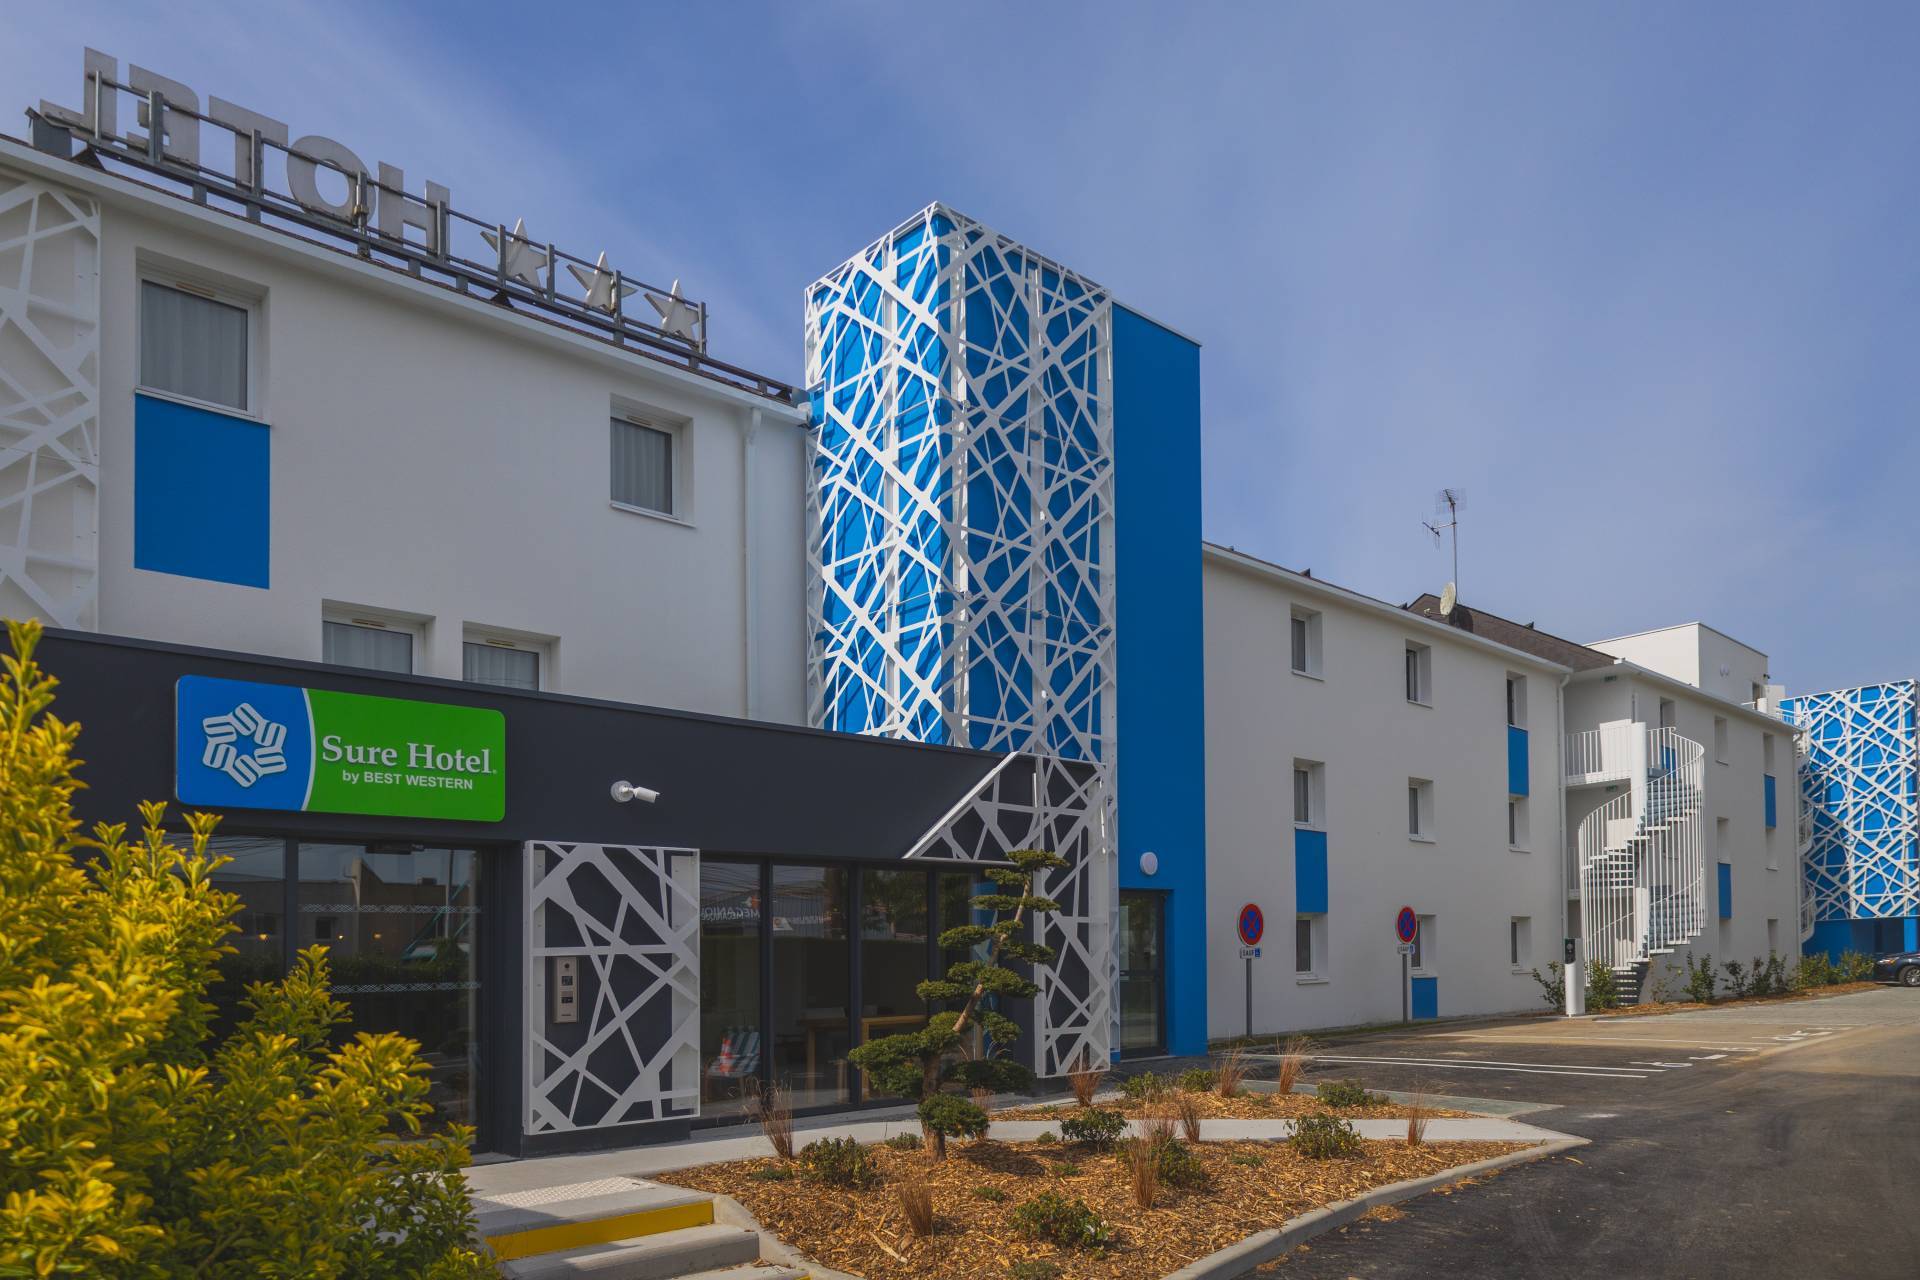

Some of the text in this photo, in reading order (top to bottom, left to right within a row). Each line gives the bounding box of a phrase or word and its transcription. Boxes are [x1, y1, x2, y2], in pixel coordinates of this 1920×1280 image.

[322, 735, 492, 774] Sure Hotel
[342, 769, 473, 790] by BEST WESTERN
